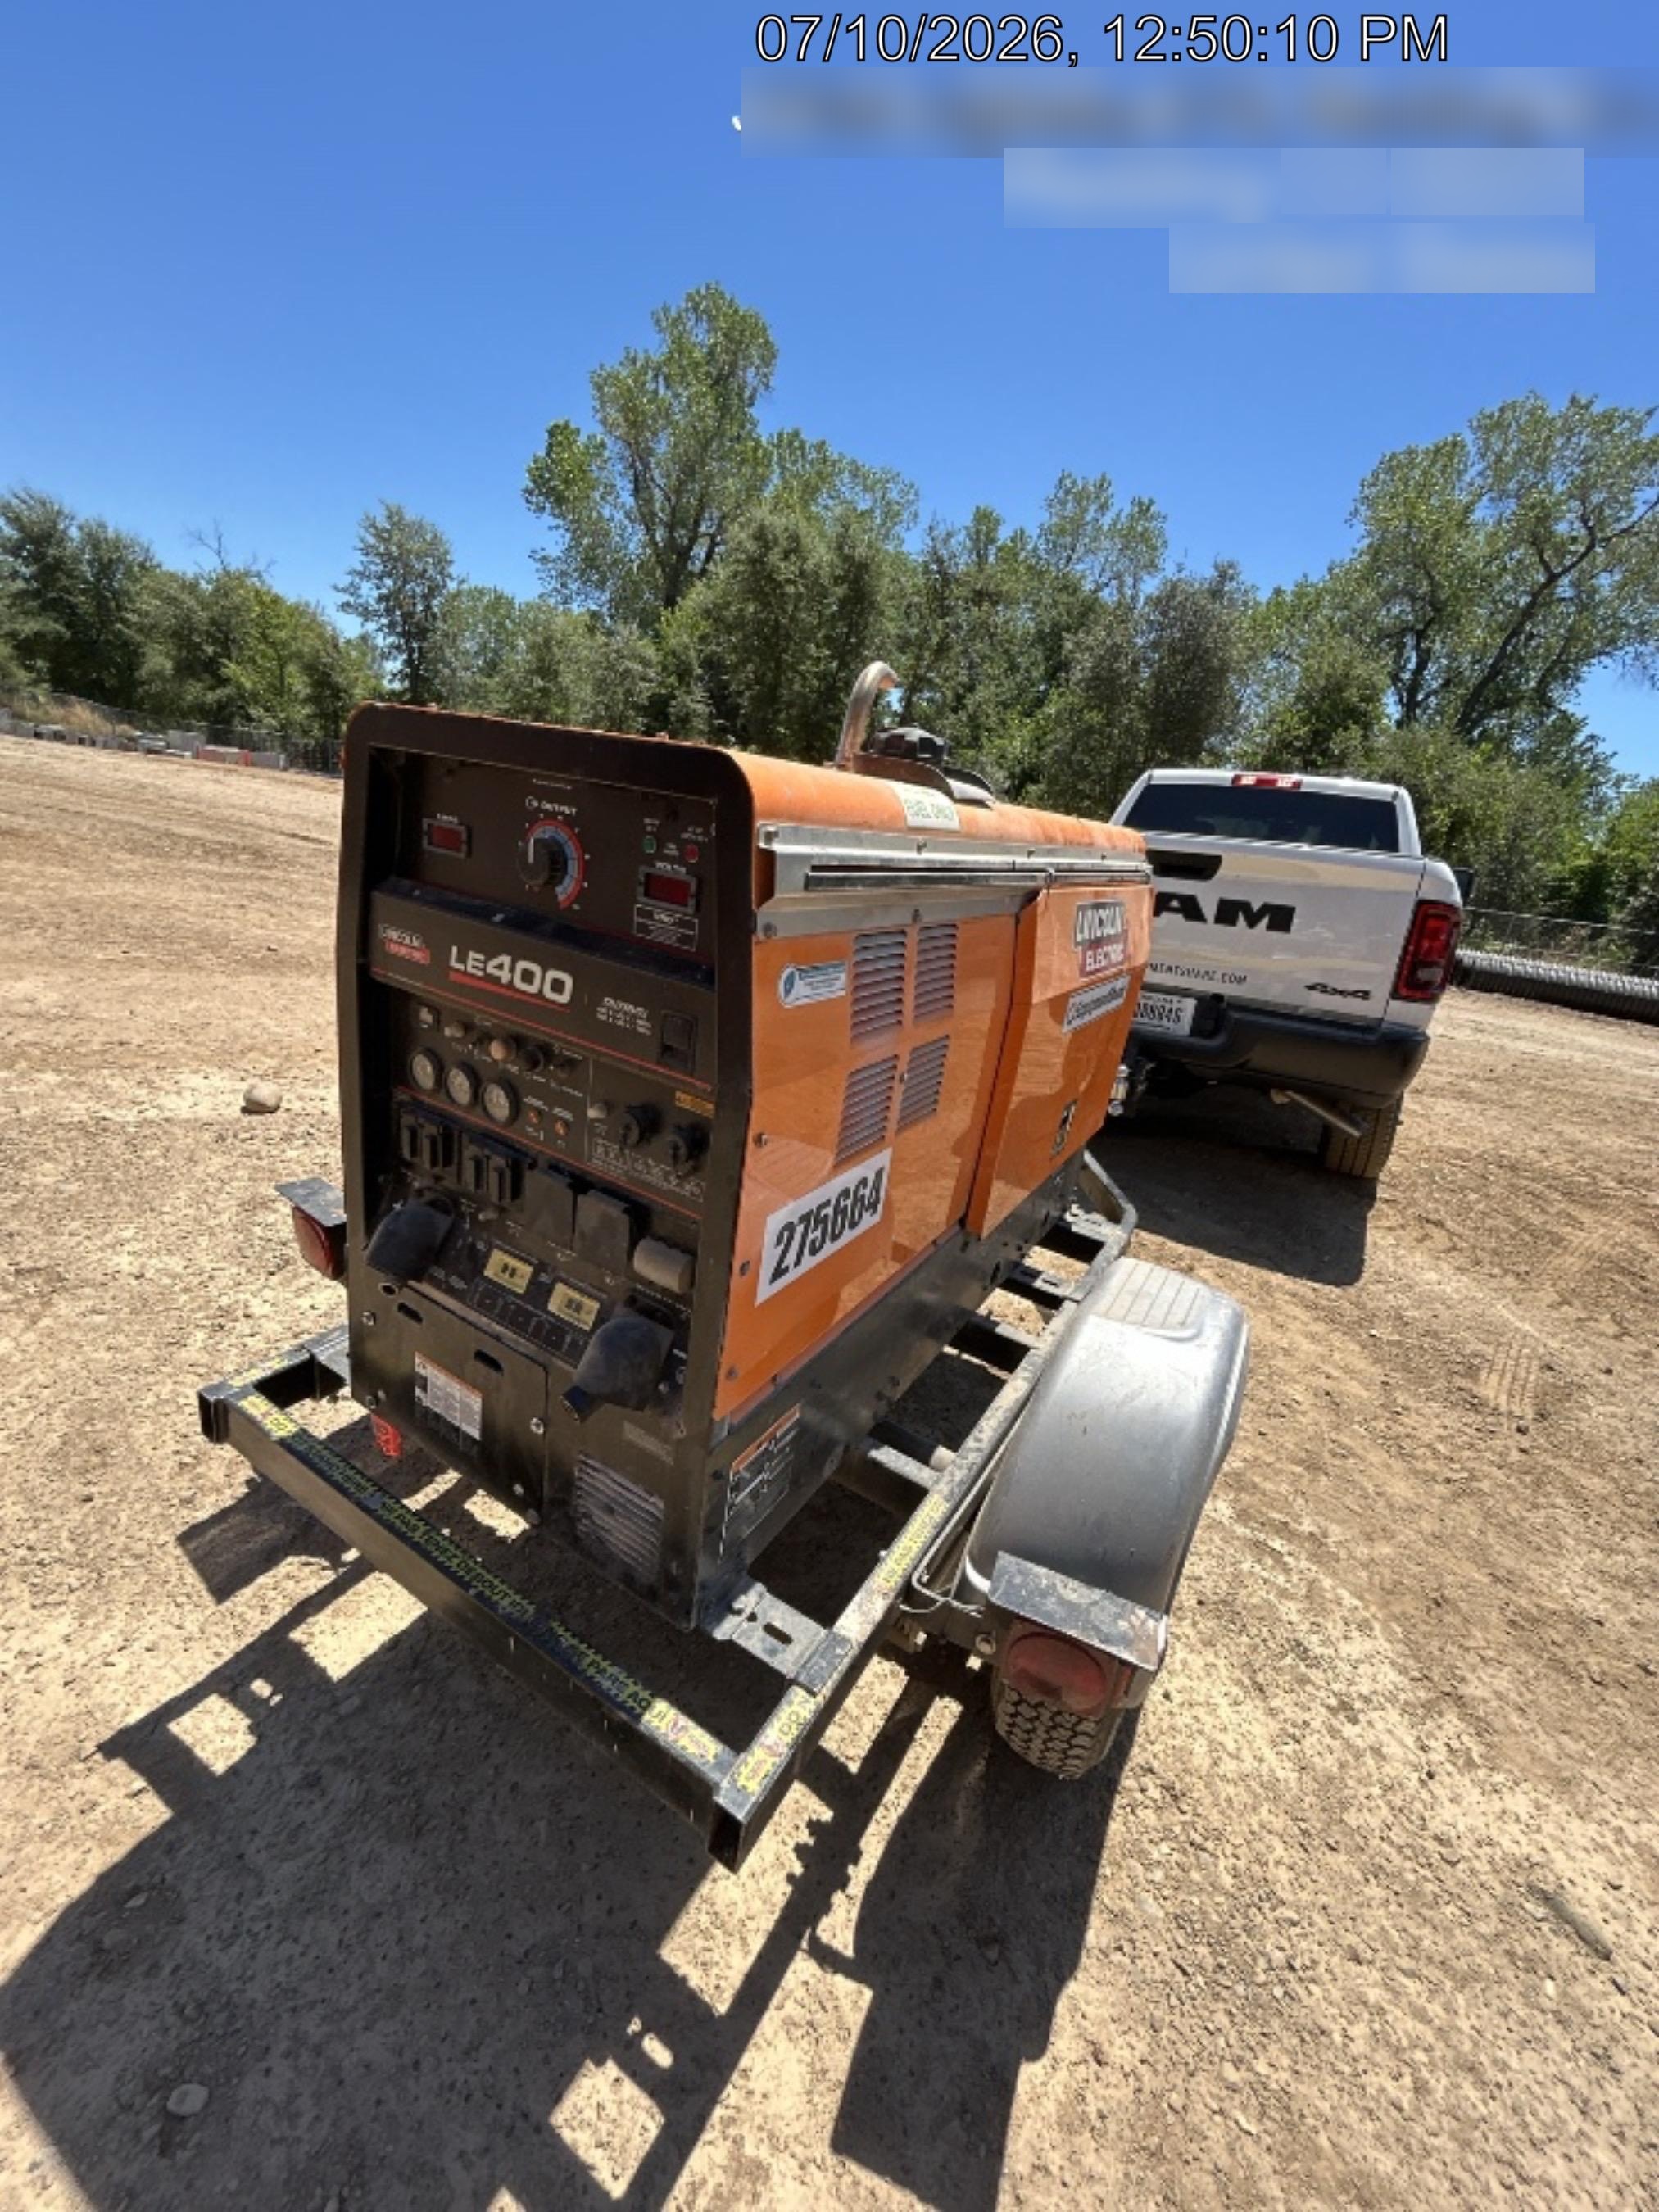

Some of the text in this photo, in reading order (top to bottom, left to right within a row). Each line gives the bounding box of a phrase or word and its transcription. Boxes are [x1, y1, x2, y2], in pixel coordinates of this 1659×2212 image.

[1076, 906, 1123, 942] LINCOLN
[450, 945, 573, 1004] LE400
[769, 1166, 885, 1286] 275664
